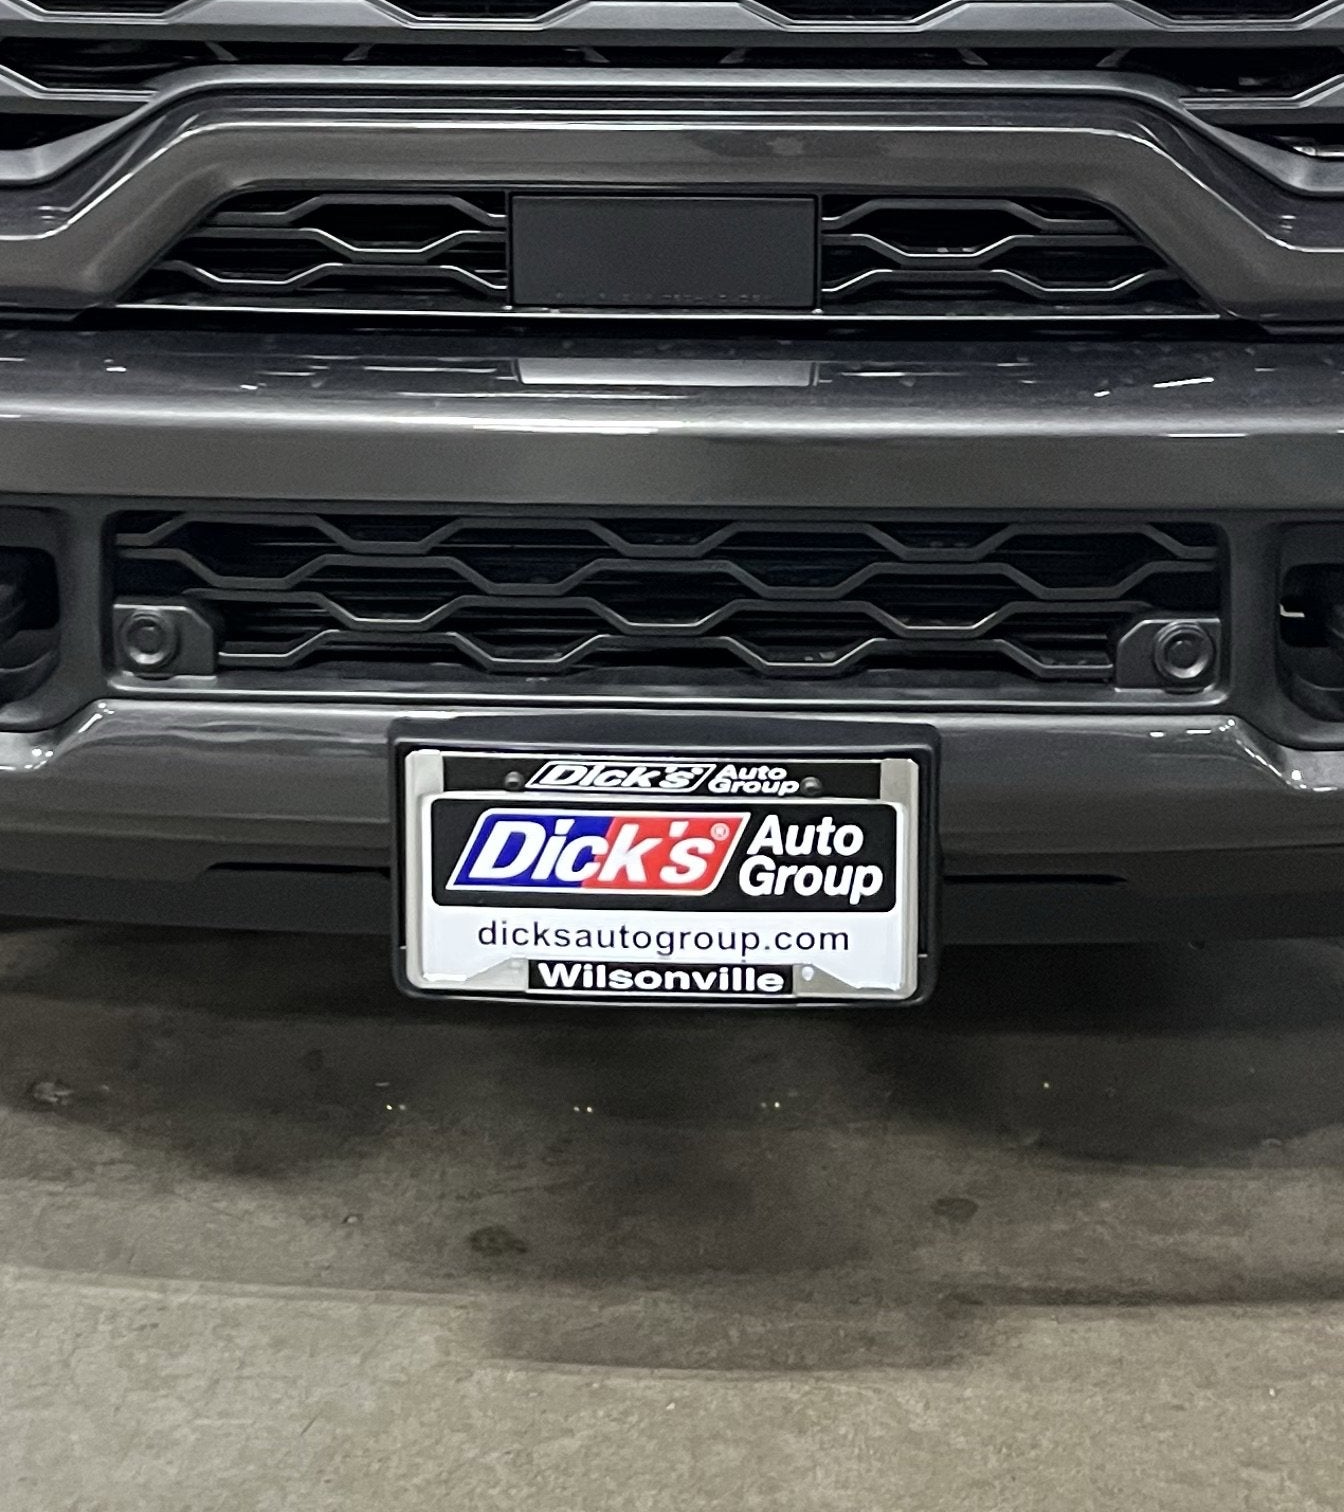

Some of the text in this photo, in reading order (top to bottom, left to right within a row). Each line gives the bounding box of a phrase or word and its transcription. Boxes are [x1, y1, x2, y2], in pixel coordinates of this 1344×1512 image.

[707, 778, 800, 796] Group
[716, 764, 788, 781] Auto
[468, 818, 714, 885] Dick's
[746, 814, 864, 857] Auto
[738, 854, 884, 905] Group
[477, 920, 850, 955] dicksautogroup.com
[537, 961, 785, 993] Wilsonville
